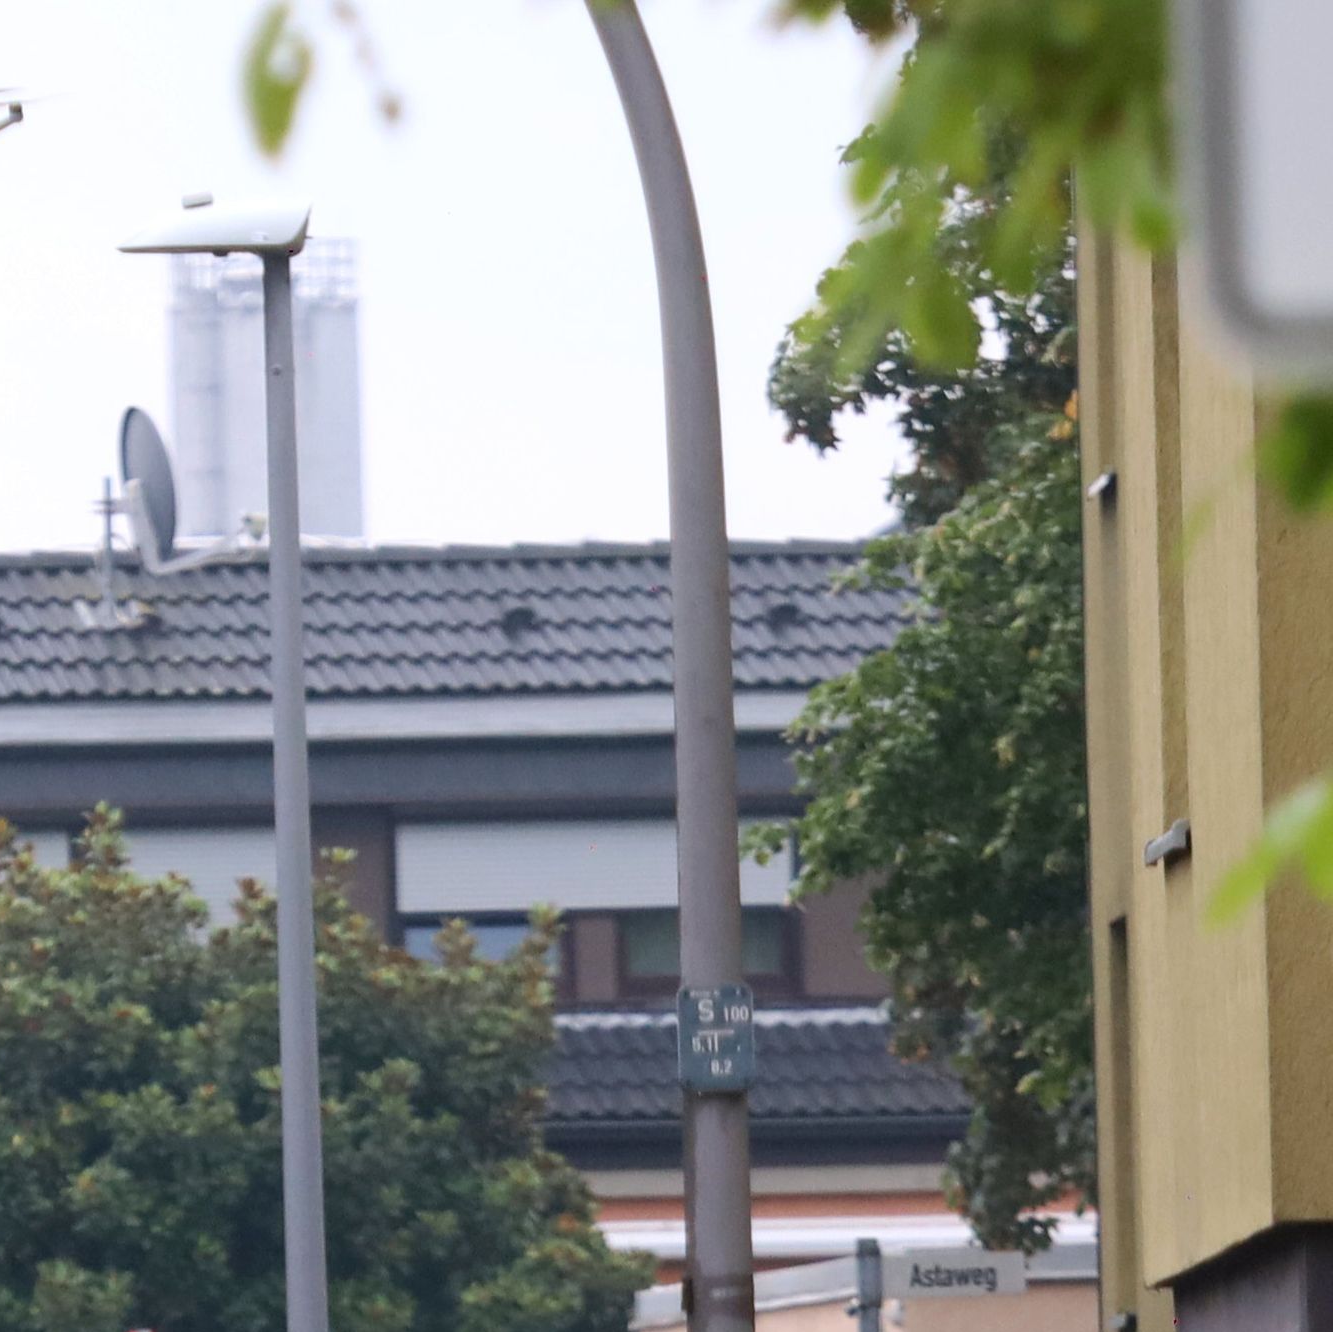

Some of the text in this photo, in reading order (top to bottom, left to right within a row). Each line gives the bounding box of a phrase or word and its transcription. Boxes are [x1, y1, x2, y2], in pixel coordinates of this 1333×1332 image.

[698, 1000, 749, 1023] S 100
[910, 1262, 997, 1292] Astaweg
